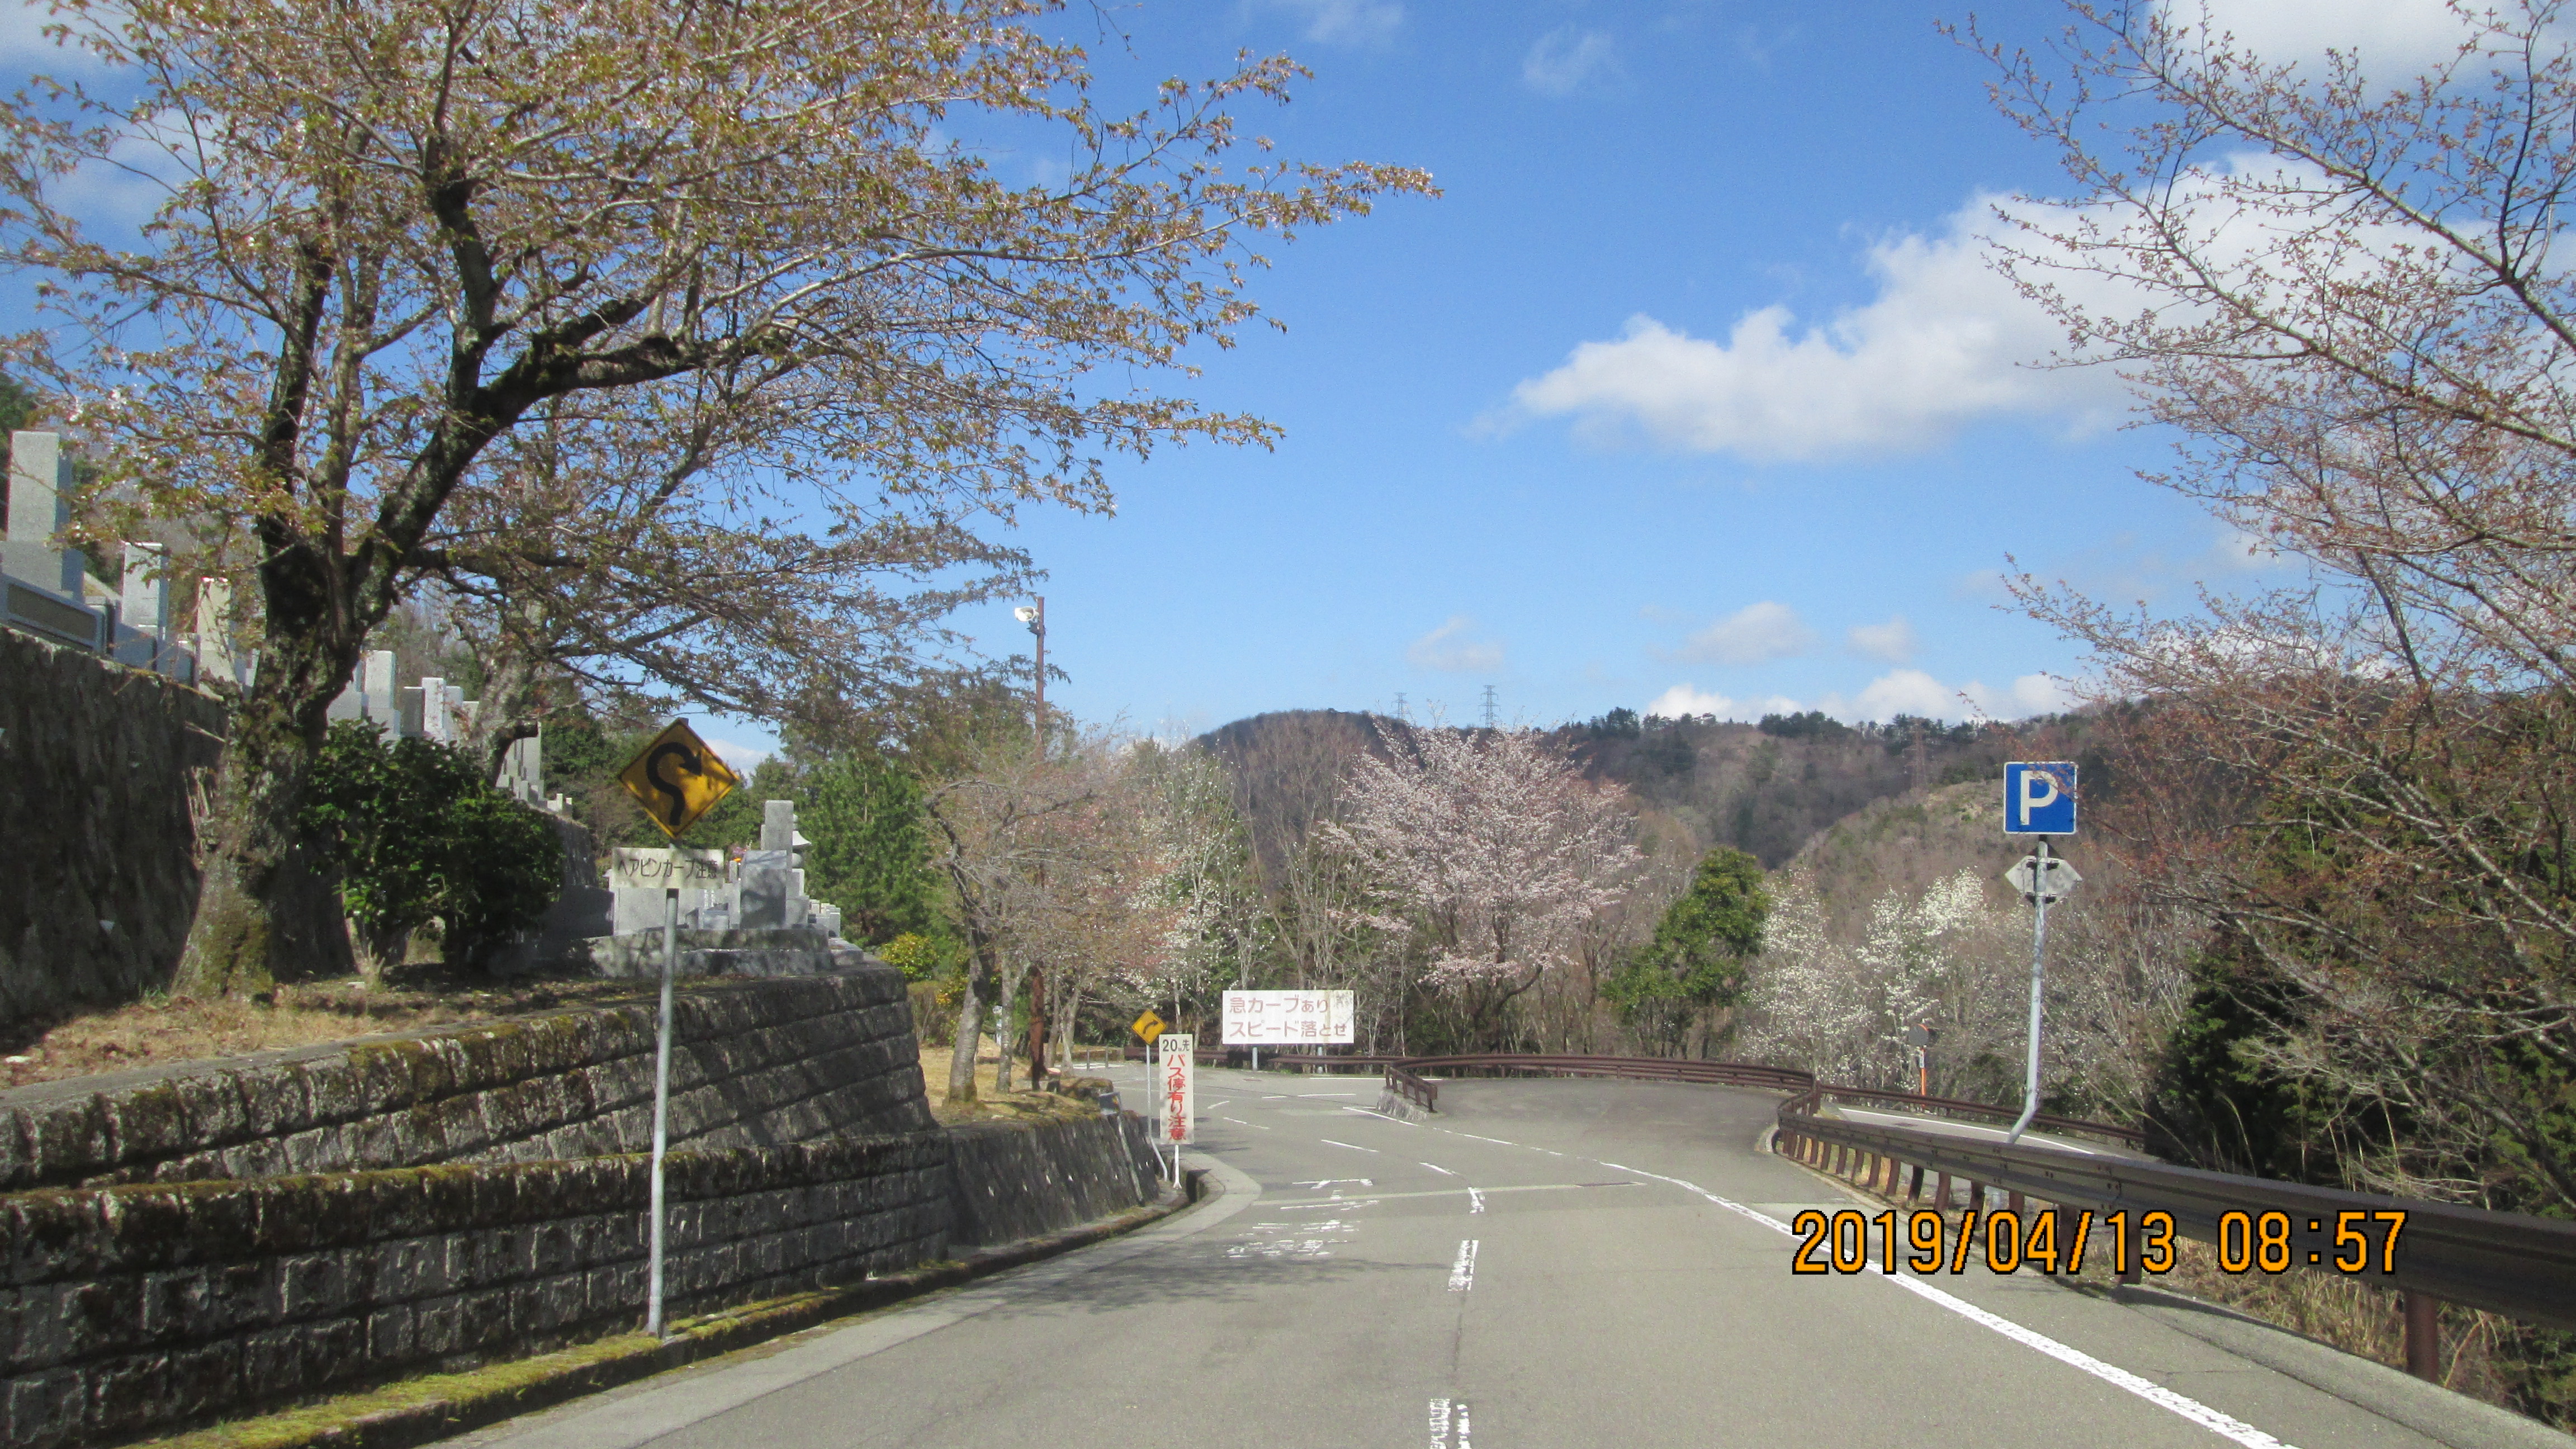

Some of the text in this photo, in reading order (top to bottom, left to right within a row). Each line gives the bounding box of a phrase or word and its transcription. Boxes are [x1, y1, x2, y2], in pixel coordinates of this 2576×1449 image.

[2021, 770, 2058, 825] P
[1229, 995, 1328, 1013] 急カーブあり
[1230, 1020, 1347, 1037] スピード落とせ
[1167, 1054, 1186, 1140] バス停有り注意
